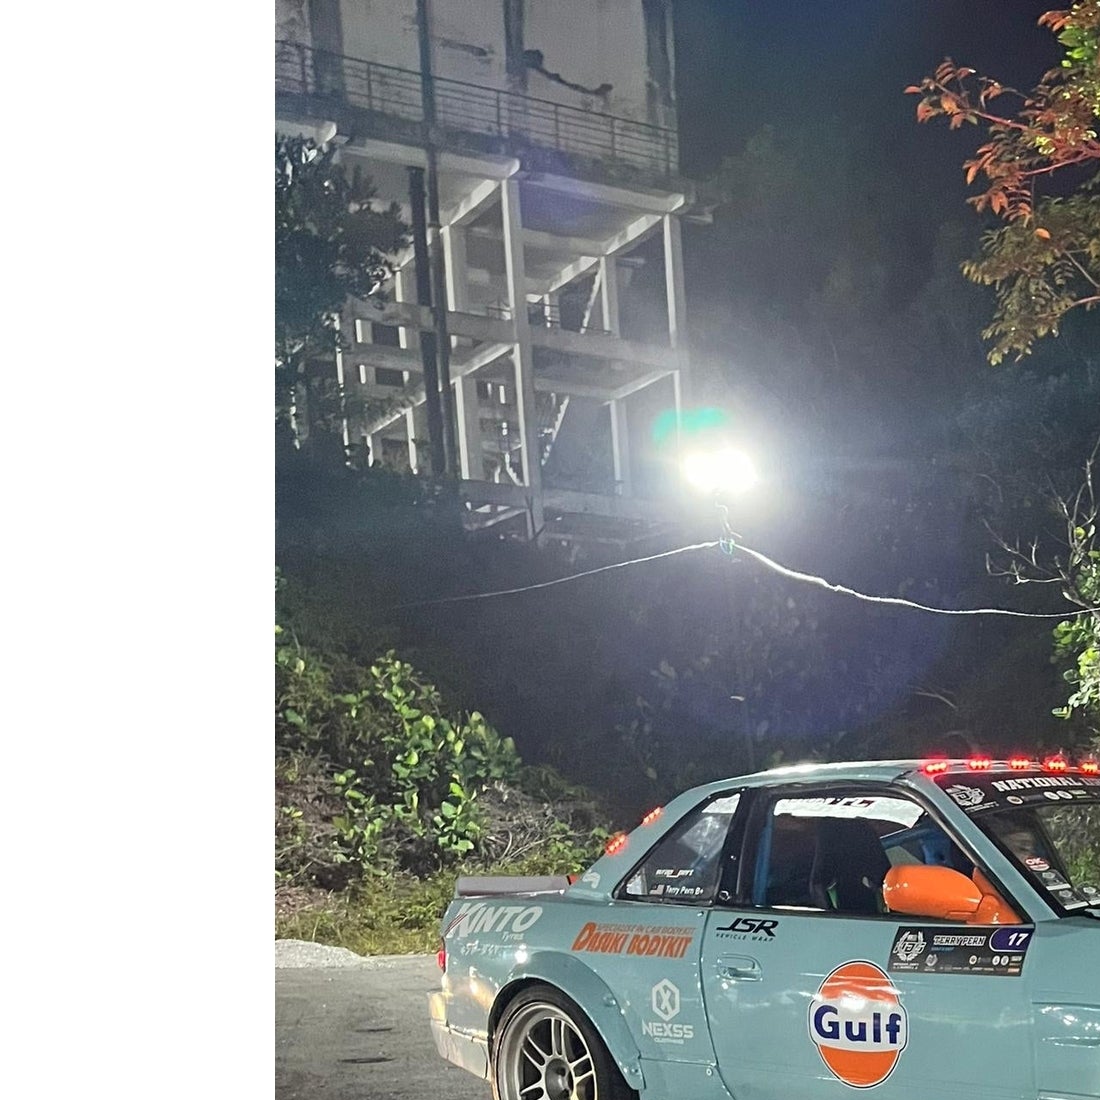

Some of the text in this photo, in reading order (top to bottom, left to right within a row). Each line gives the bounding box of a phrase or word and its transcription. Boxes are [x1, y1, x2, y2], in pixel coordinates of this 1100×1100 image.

[991, 776, 1083, 792] NATIONAL
[446, 902, 543, 938] KINTO
[716, 917, 779, 938] JSR
[626, 934, 693, 958] BODYKIT
[1008, 932, 1029, 947] 17
[642, 1019, 694, 1039] NEXSS
[814, 1004, 902, 1044] Gulf
